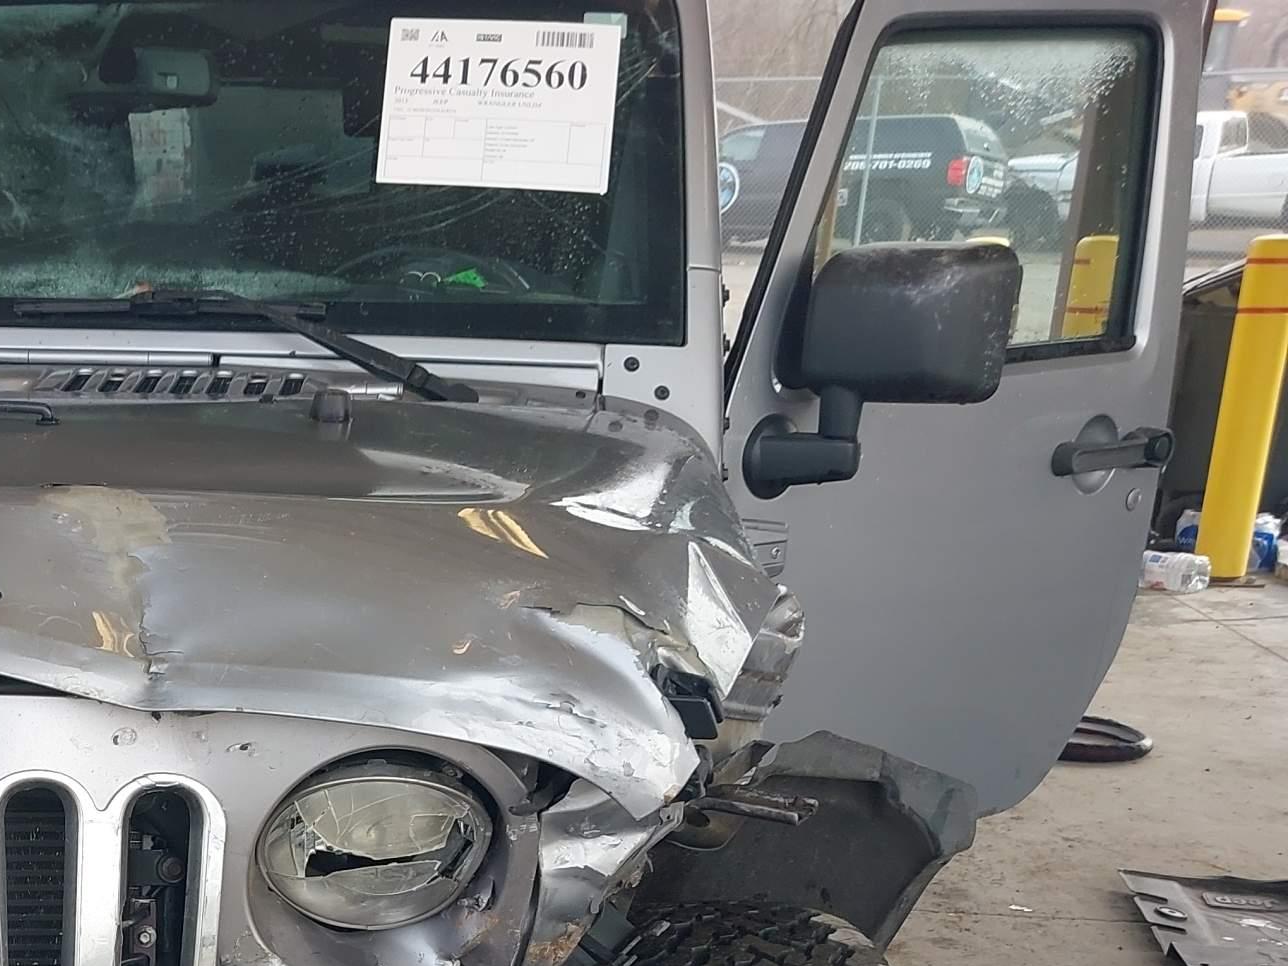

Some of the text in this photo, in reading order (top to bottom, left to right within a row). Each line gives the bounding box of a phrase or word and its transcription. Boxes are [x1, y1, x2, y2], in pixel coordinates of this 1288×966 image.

[409, 55, 588, 90] 44176560
[394, 86, 535, 98] Progressive Casualty Insurance
